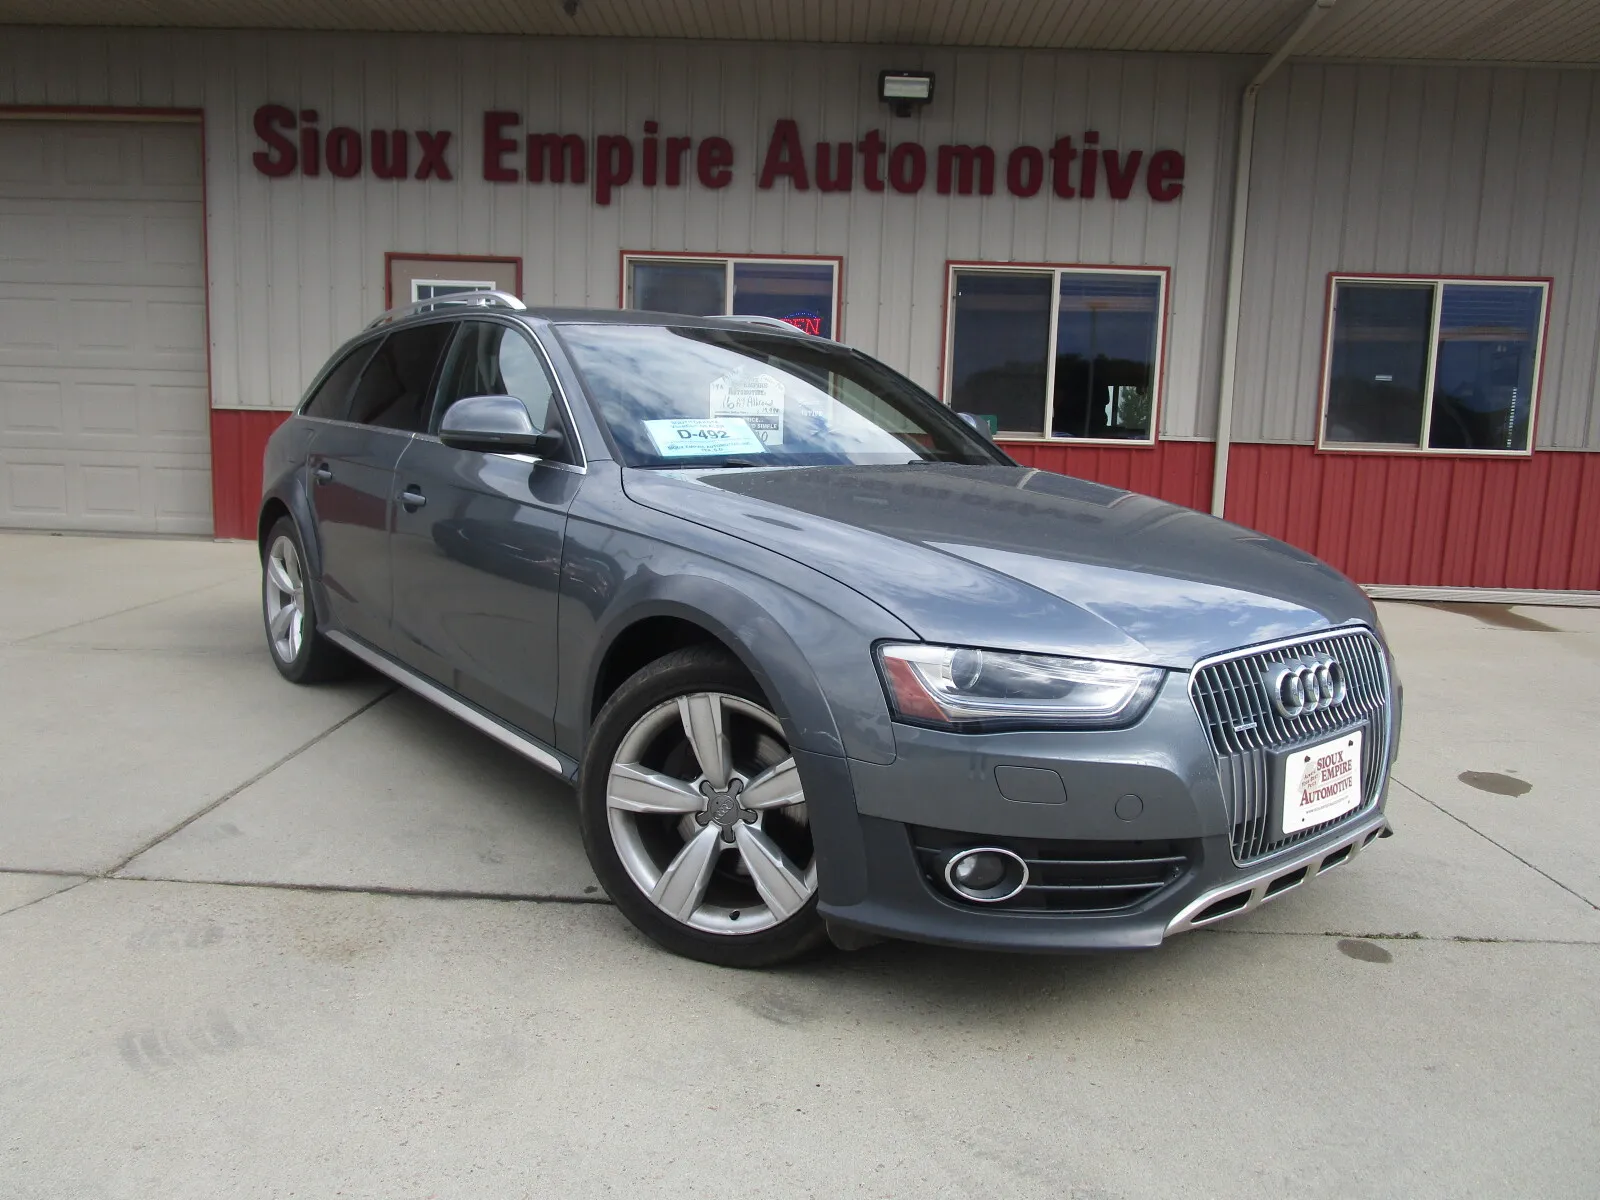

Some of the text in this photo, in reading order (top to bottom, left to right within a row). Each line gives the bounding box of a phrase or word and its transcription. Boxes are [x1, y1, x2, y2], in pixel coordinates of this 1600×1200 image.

[252, 104, 1186, 206] Sioux Empire Automotive
[676, 429, 731, 440] D-492
[1317, 750, 1343, 771] SIOUX
[1321, 759, 1352, 782] EMPIRE
[1299, 776, 1352, 807] AUTOMOTIVE
